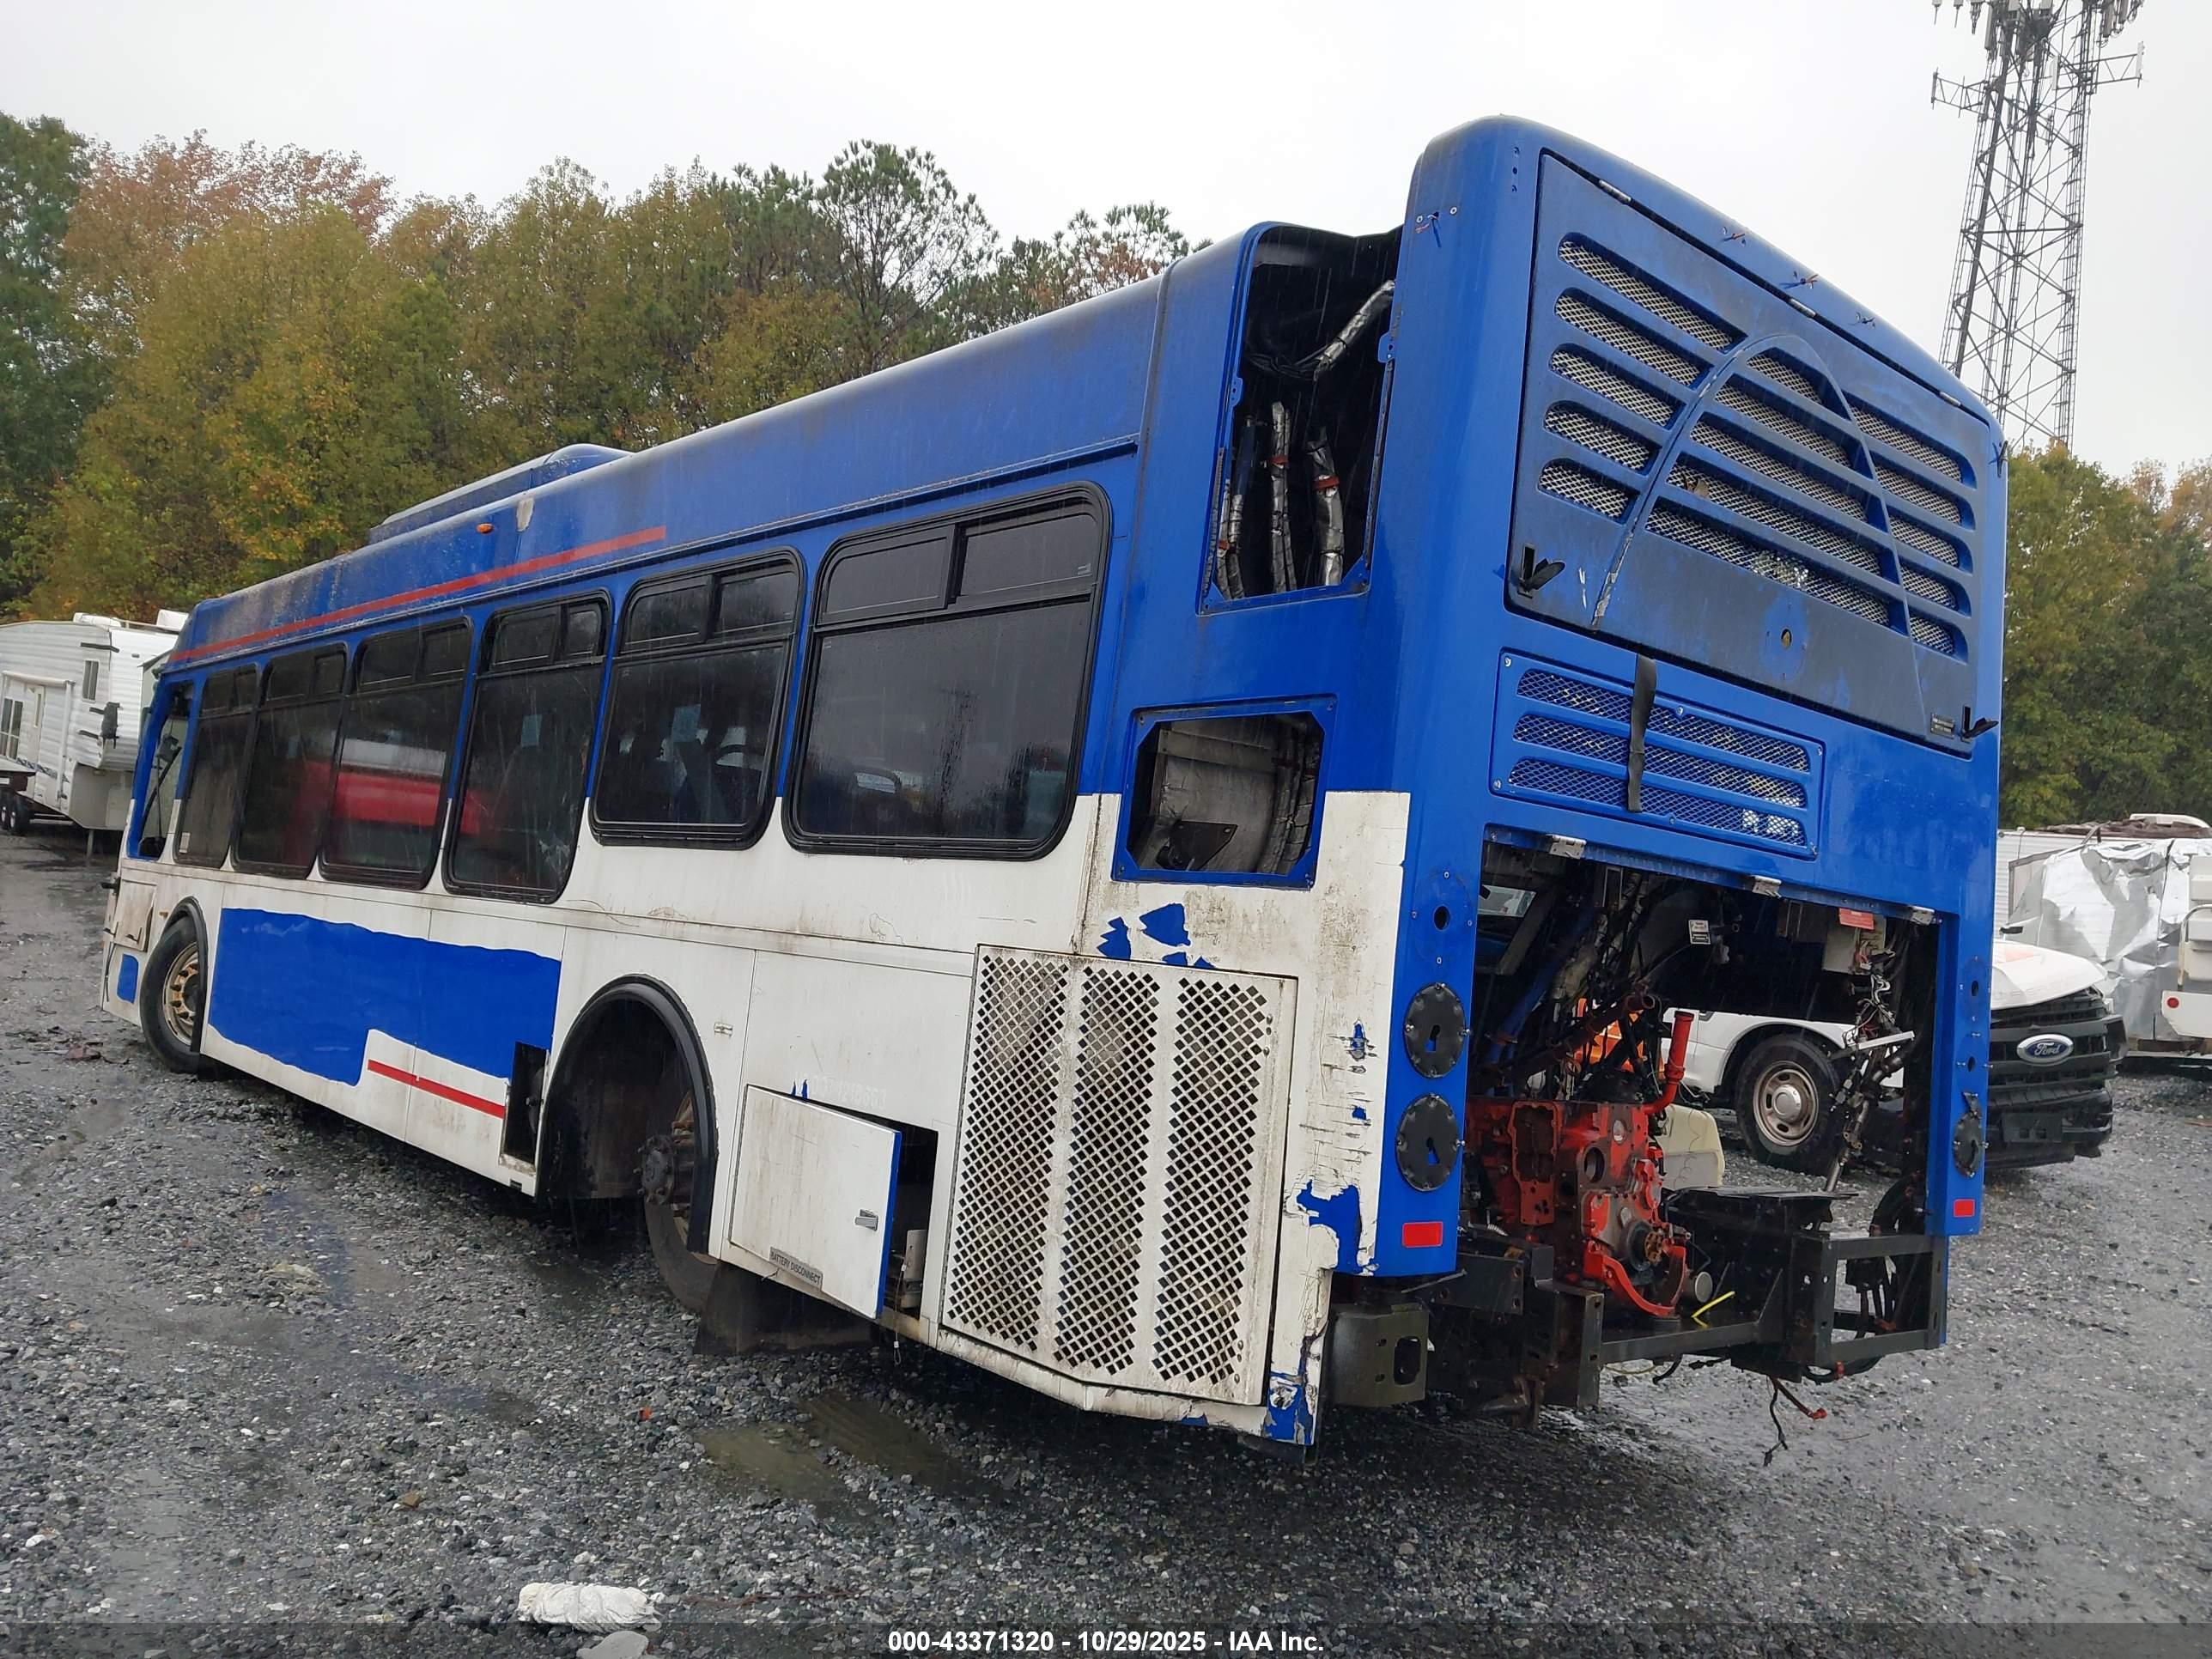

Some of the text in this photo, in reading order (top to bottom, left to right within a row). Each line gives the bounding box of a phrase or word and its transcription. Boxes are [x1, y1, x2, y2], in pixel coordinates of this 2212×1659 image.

[2034, 1042, 2061, 1055] Ford
[770, 1251, 821, 1285] BATTERY DISCONNECT
